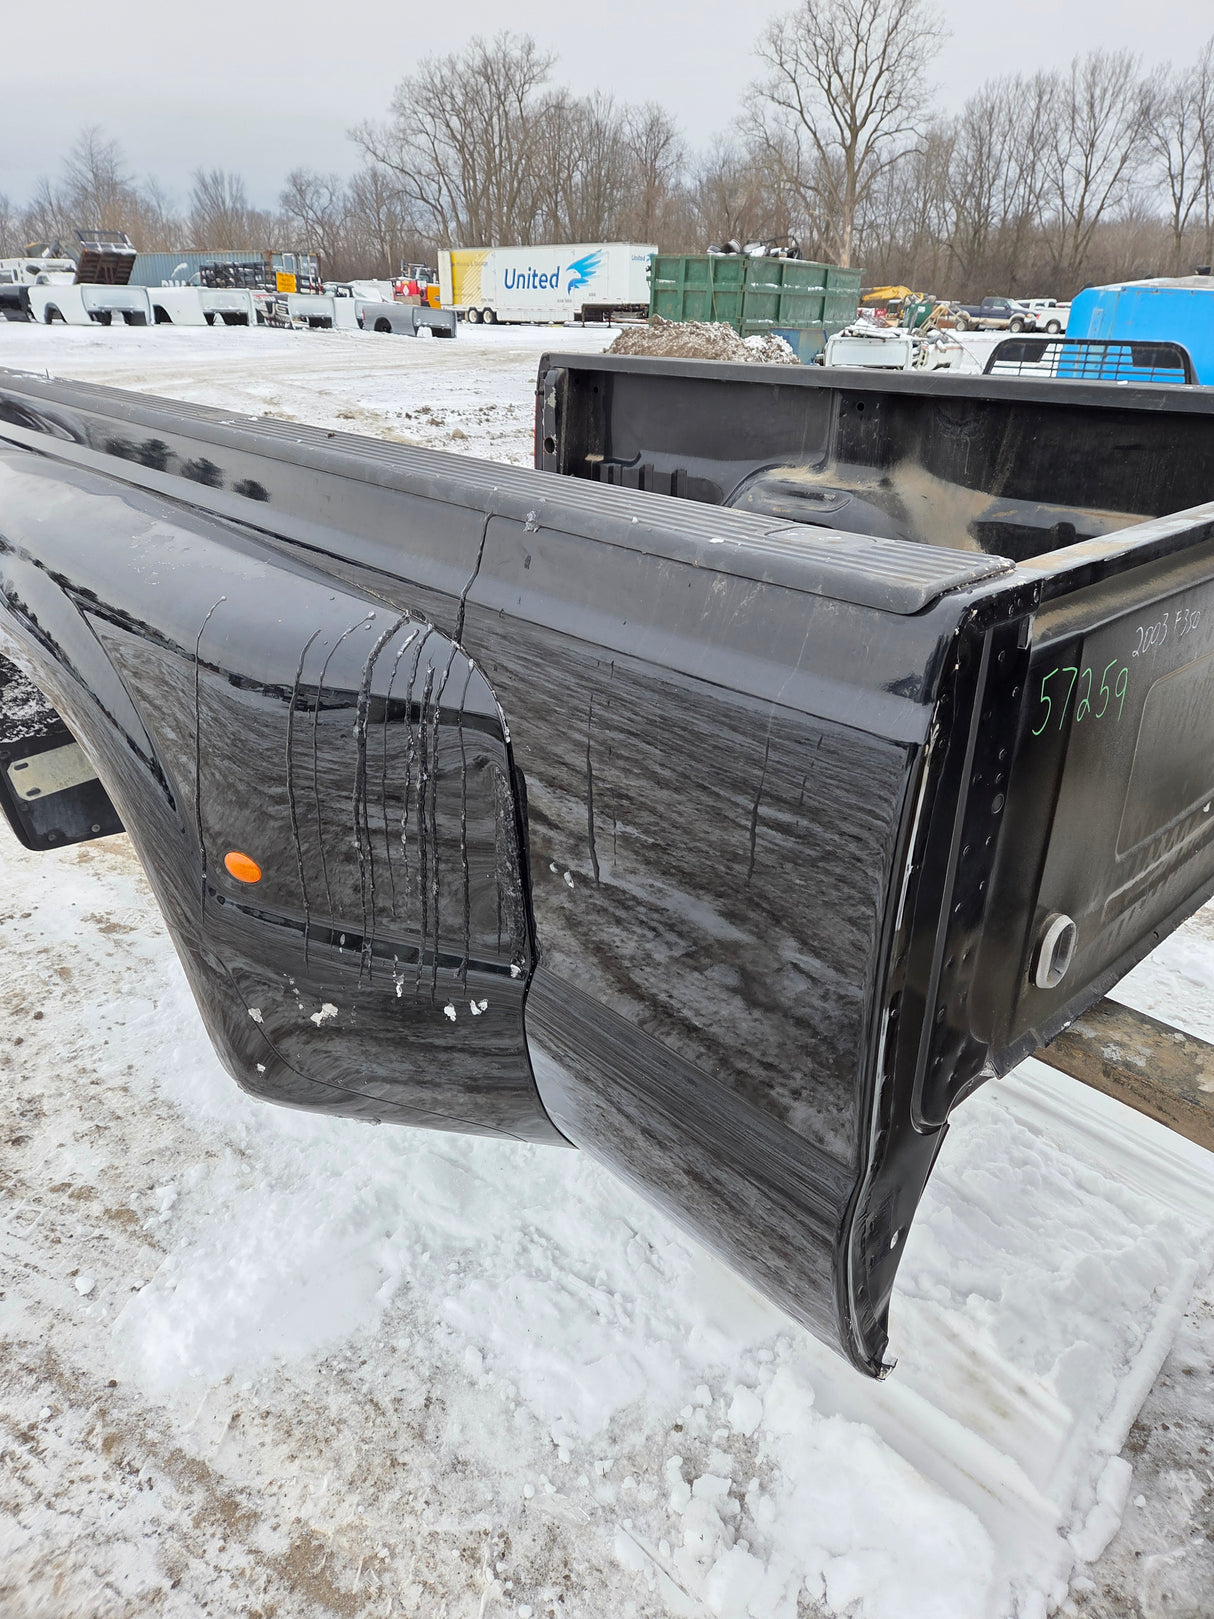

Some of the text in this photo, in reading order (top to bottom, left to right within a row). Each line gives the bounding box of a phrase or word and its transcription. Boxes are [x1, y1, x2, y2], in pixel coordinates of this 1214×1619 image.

[504, 266, 560, 290] United
[1131, 608, 1201, 657] 2003 F350
[1031, 658, 1129, 736] 57259
